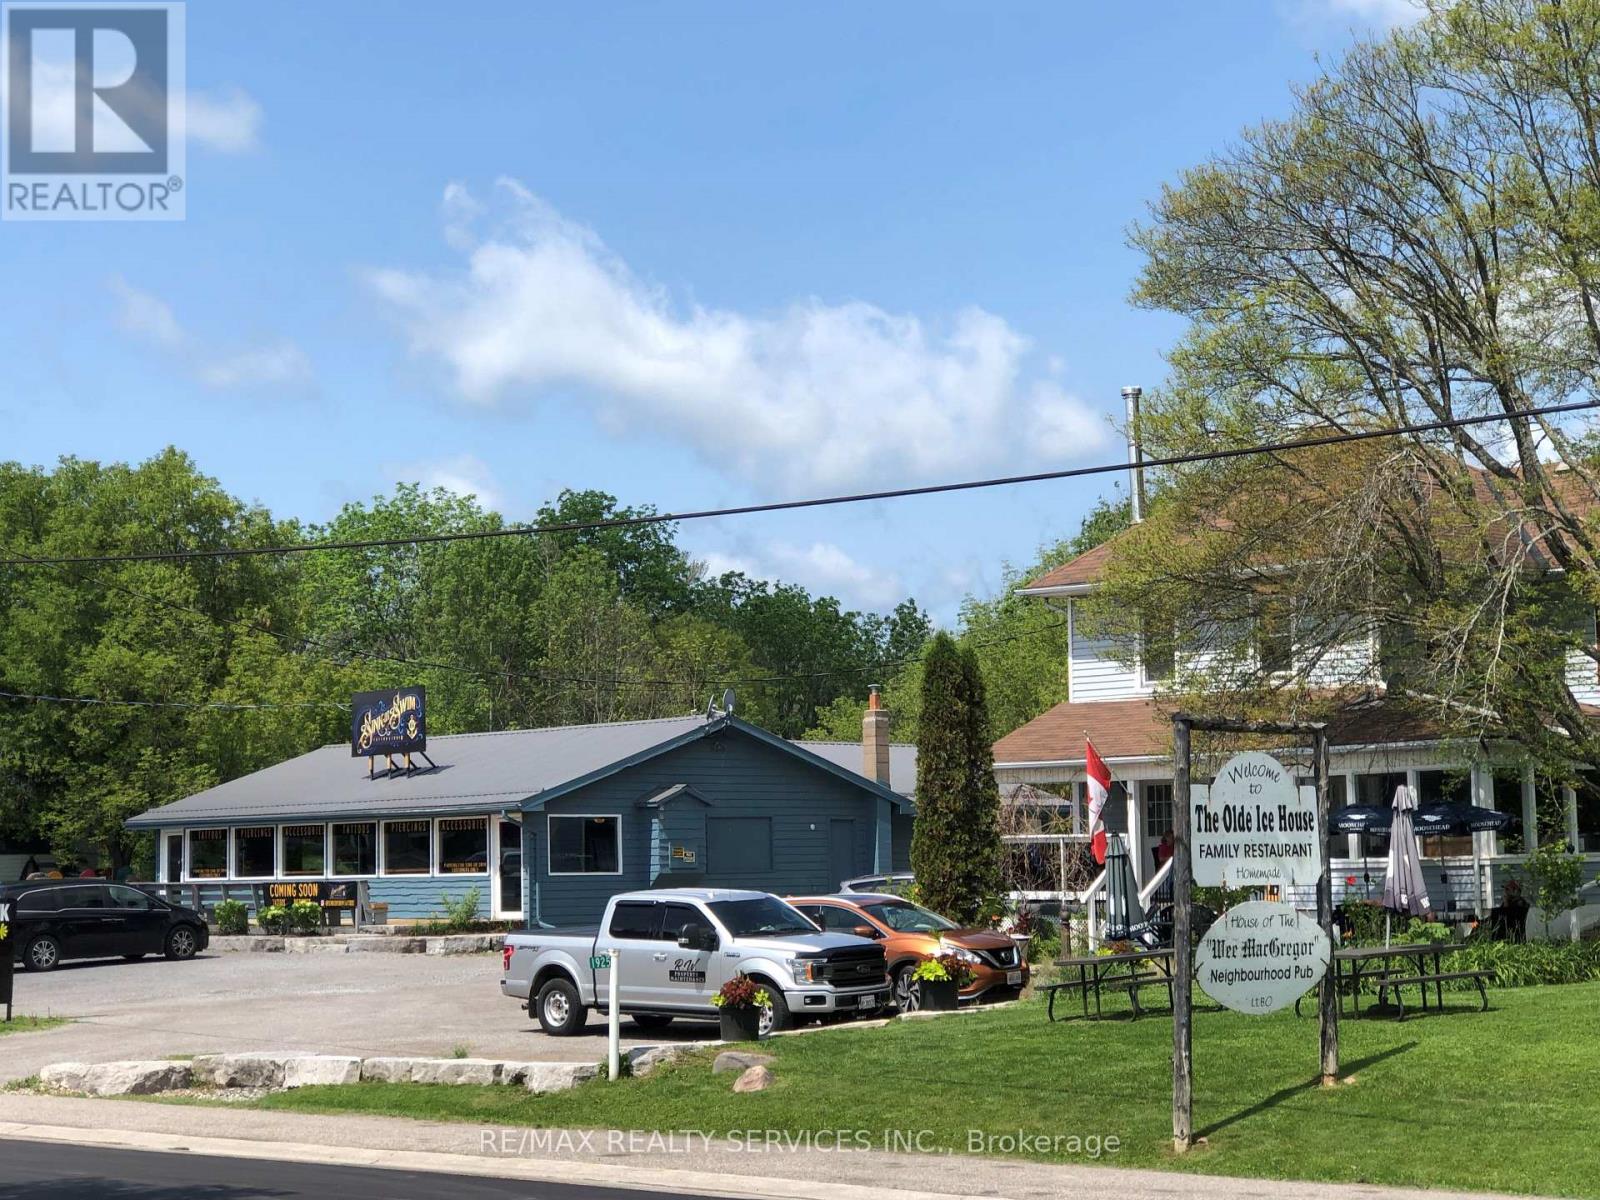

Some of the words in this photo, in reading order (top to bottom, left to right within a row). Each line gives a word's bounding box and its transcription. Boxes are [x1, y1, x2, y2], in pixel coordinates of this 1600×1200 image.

[1228, 762, 1281, 785] Welcome
[1249, 783, 1262, 795] to
[1195, 804, 1219, 833] The
[1222, 804, 1251, 833] Olde
[1256, 805, 1274, 832] Ice
[1278, 804, 1315, 832] House
[1199, 844, 1240, 859] FAMILY
[1244, 843, 1313, 859] RESTAURANT
[1236, 866, 1281, 880] Homemade
[269, 884, 297, 898] COMING
[298, 884, 318, 897] SOON
[1231, 915, 1259, 928] House
[1278, 914, 1295, 928] The
[591, 956, 610, 968] 1925
[1210, 966, 1291, 986] Neighbourhood
[1294, 965, 1314, 979] Pub
